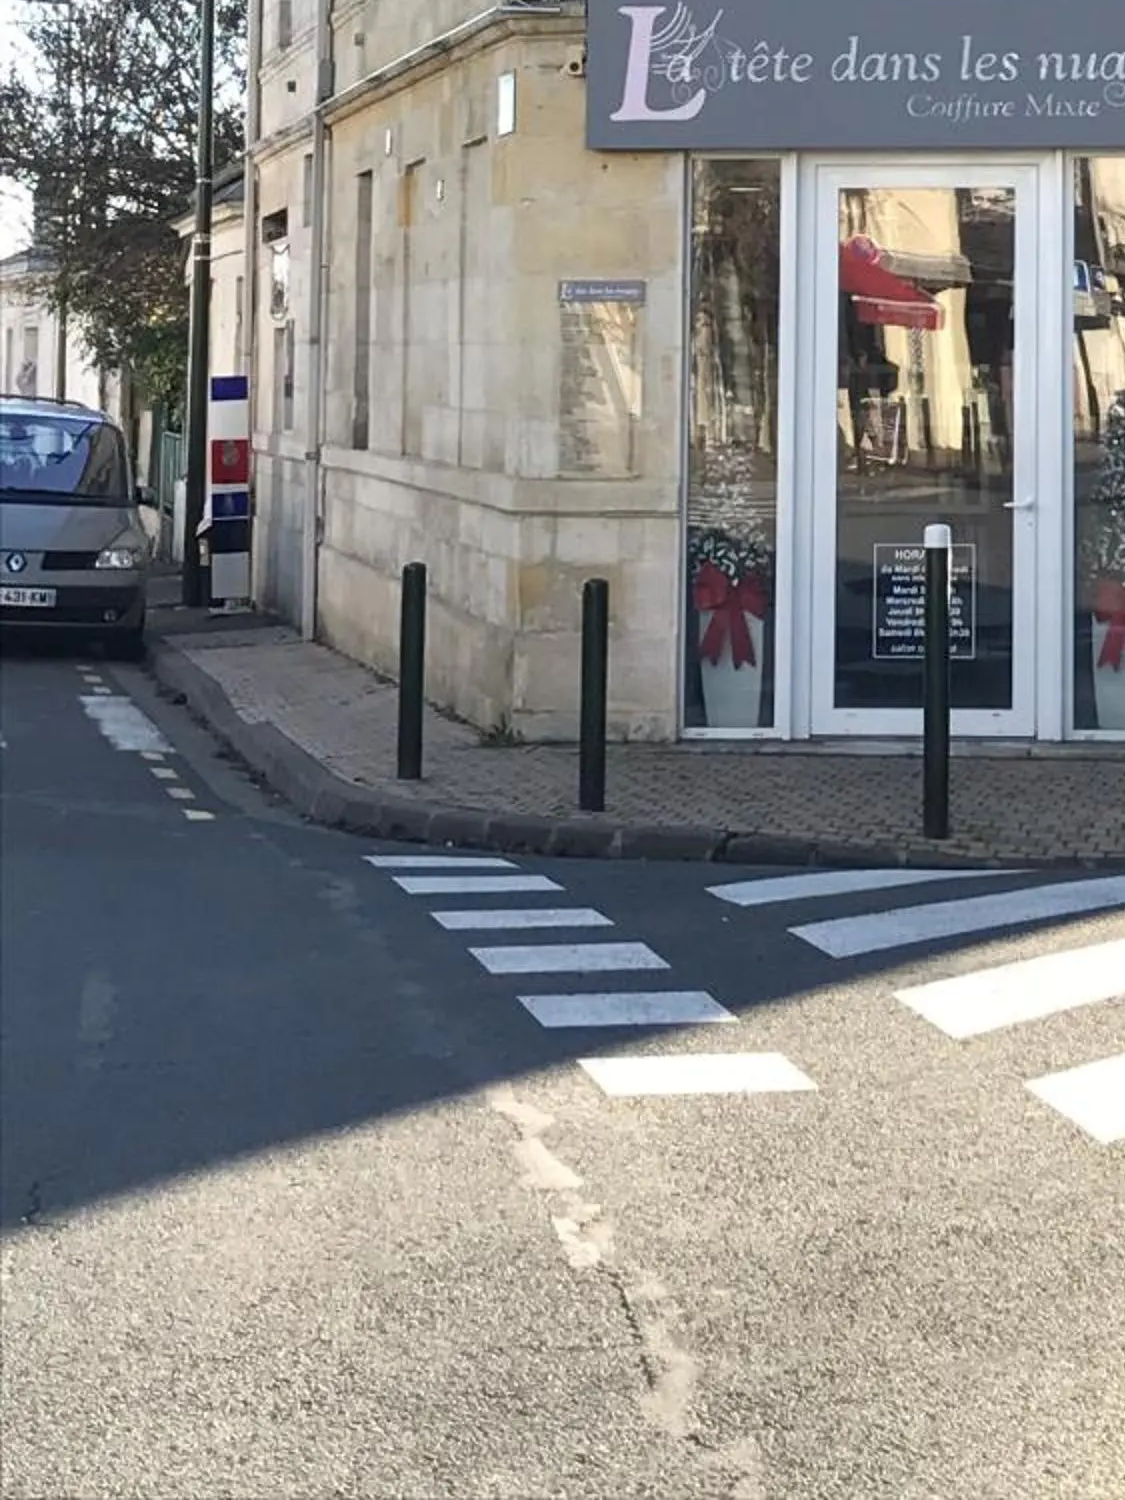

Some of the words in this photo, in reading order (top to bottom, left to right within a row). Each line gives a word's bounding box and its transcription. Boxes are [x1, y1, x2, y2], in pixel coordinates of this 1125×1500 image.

[609, 5, 707, 121] La
[727, 40, 813, 82] tête
[831, 35, 943, 82] dans
[959, 35, 1021, 81] les
[906, 93, 1016, 123] Coiffure
[1024, 93, 1101, 118] Mixte
